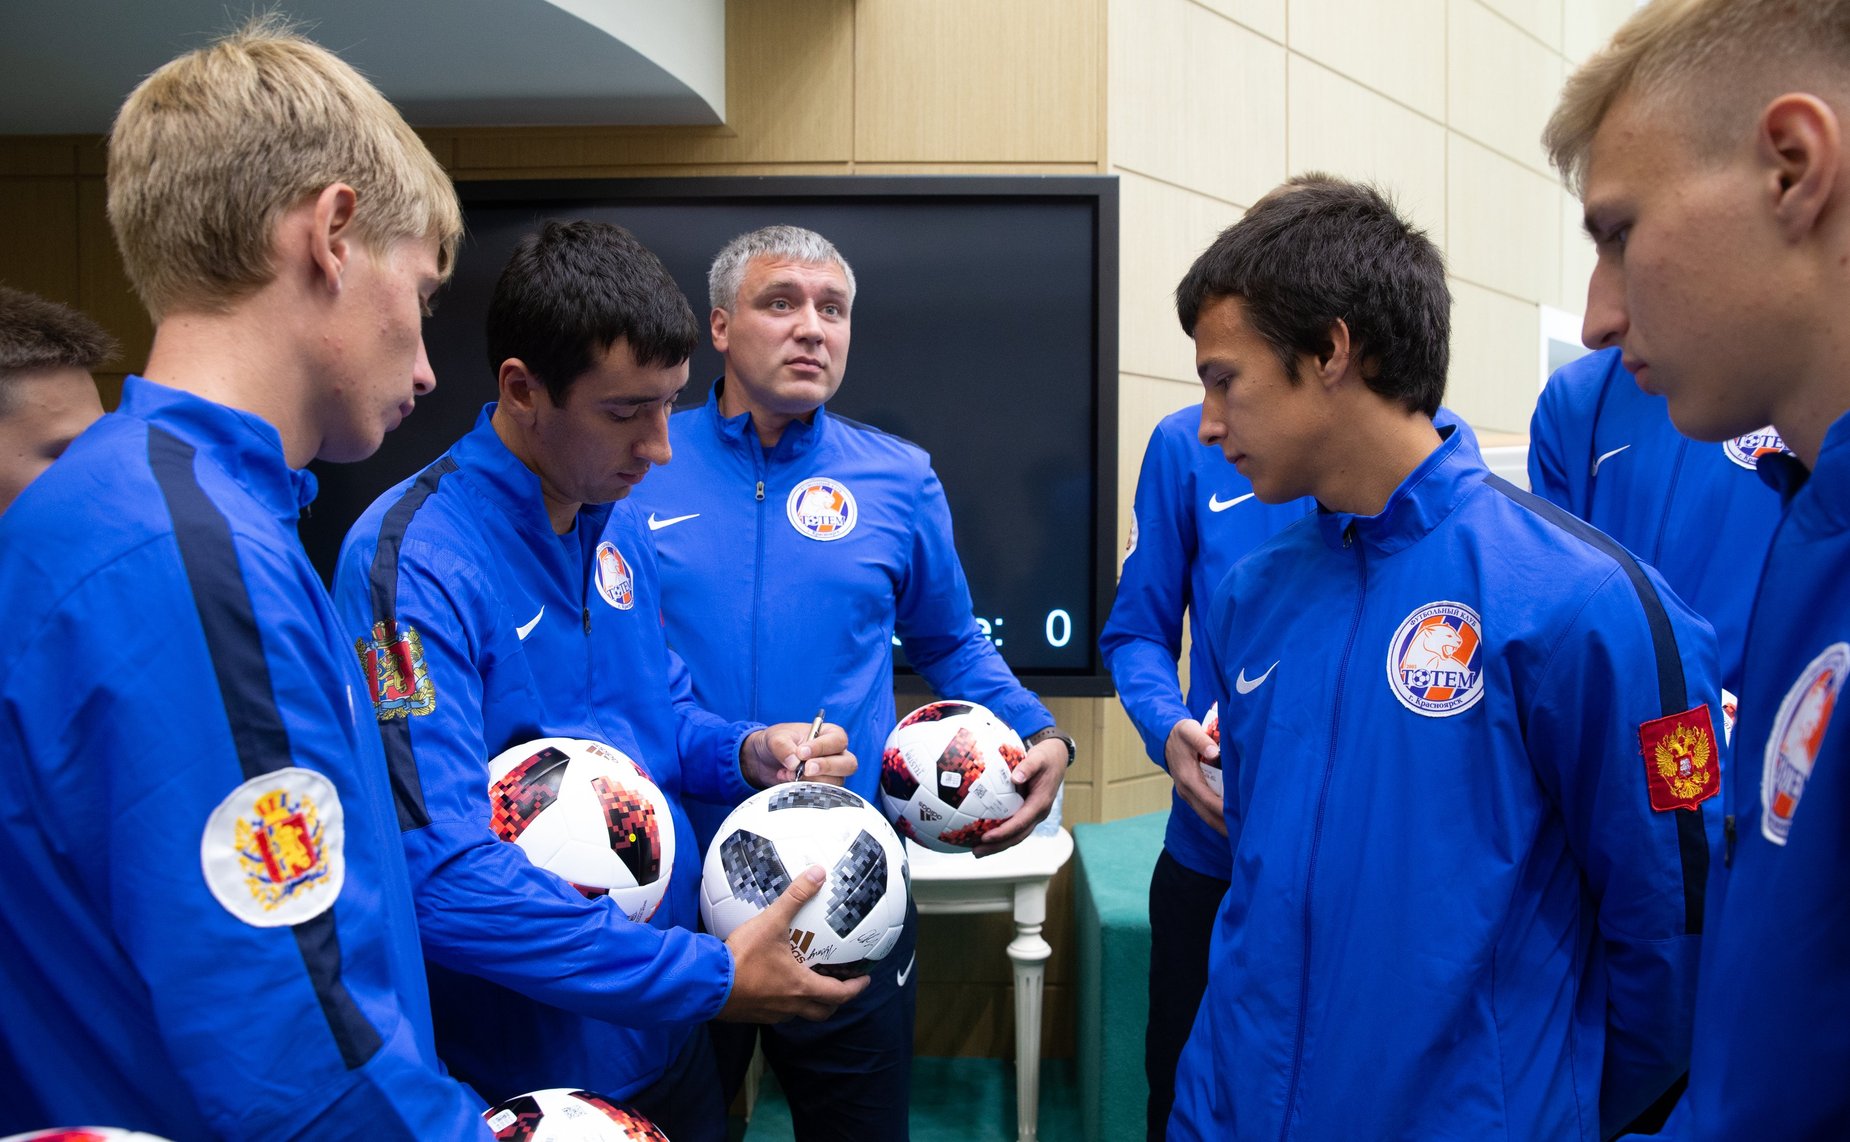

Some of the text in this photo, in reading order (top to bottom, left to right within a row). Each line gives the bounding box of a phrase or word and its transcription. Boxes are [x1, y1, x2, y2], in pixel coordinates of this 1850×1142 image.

[1736, 434, 1789, 450] ТОТЕ
[1410, 607, 1477, 628] ФУТБОЛЬНЫЙ КЛУБ
[1045, 609, 1072, 648] 0
[1415, 697, 1464, 709] Красноярск
